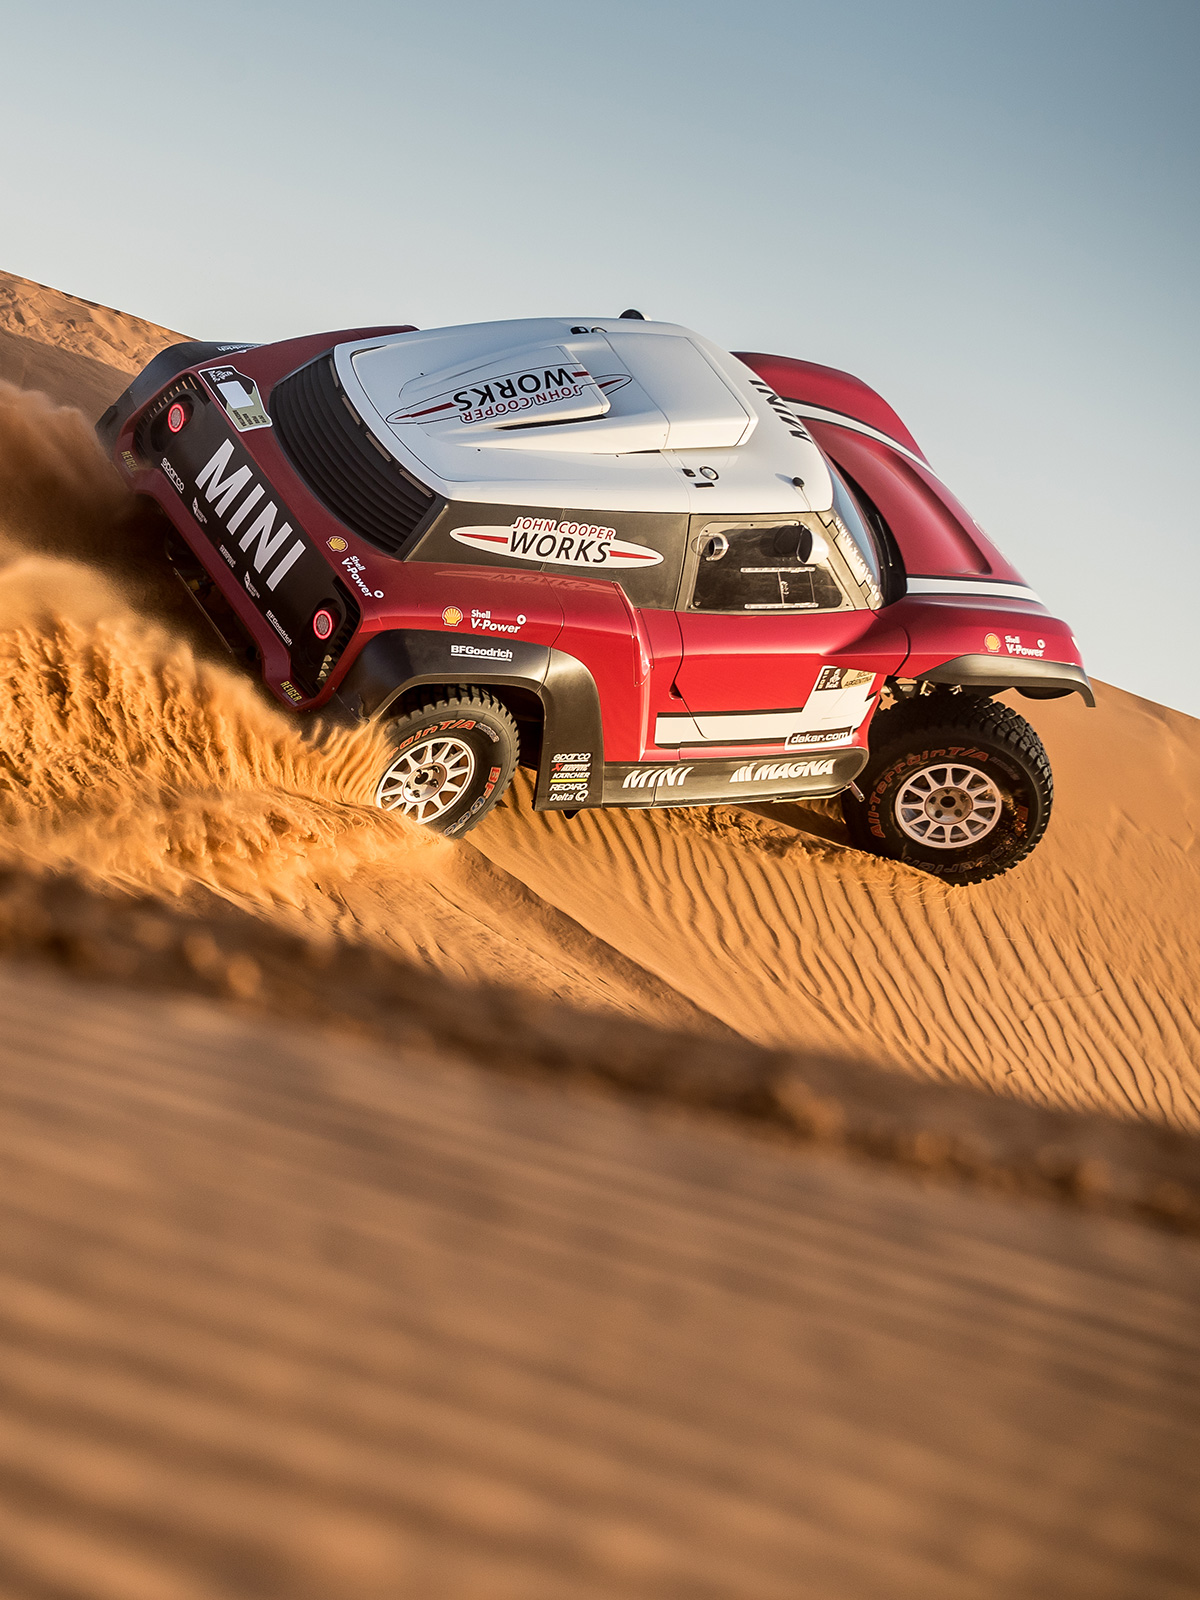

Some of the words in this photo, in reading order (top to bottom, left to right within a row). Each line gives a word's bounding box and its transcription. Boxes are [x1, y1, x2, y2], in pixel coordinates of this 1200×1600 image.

[453, 368, 575, 412] WORKS
[535, 384, 582, 404] JOHN
[462, 396, 530, 422] COOPER
[161, 457, 185, 492] sparco
[195, 438, 306, 591] MINI
[513, 518, 555, 532] JOHN
[558, 522, 614, 540] COOPER
[509, 531, 611, 563] WORKS
[350, 555, 366, 571] Shell
[341, 557, 373, 597] V-Power
[471, 609, 491, 619] Shell
[266, 610, 292, 646] BFGoodrich
[471, 618, 521, 634] V-Power
[1005, 635, 1020, 644] Shell
[1006, 643, 1044, 657] V-Power
[451, 644, 513, 660] BFGoodrich
[280, 680, 302, 702] REIGER
[790, 731, 848, 744] dakar.com
[552, 753, 591, 762] sparco
[622, 767, 694, 788] MINI
[753, 759, 836, 781] MAGNA
[549, 783, 588, 791] RECARO
